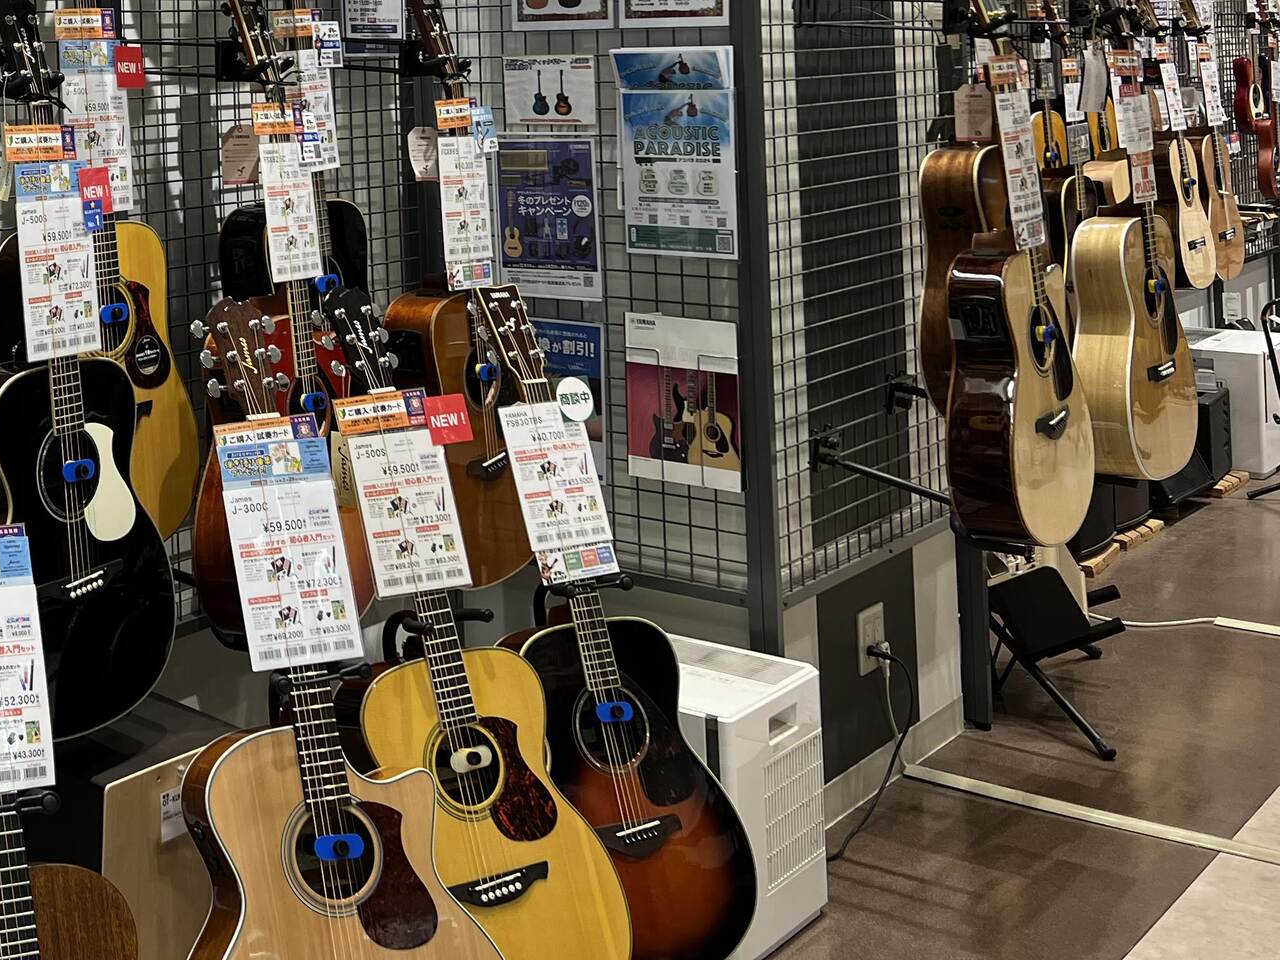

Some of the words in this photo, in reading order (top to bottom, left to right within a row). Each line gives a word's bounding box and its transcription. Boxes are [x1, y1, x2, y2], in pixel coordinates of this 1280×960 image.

[634, 126, 720, 140] ACOUSTIC
[634, 141, 720, 156] PARADISE
[518, 196, 571, 205] 冬のプレゼント
[519, 207, 571, 216] キャンペーン
[558, 392, 589, 406] 商談中
[230, 496, 252, 504] James
